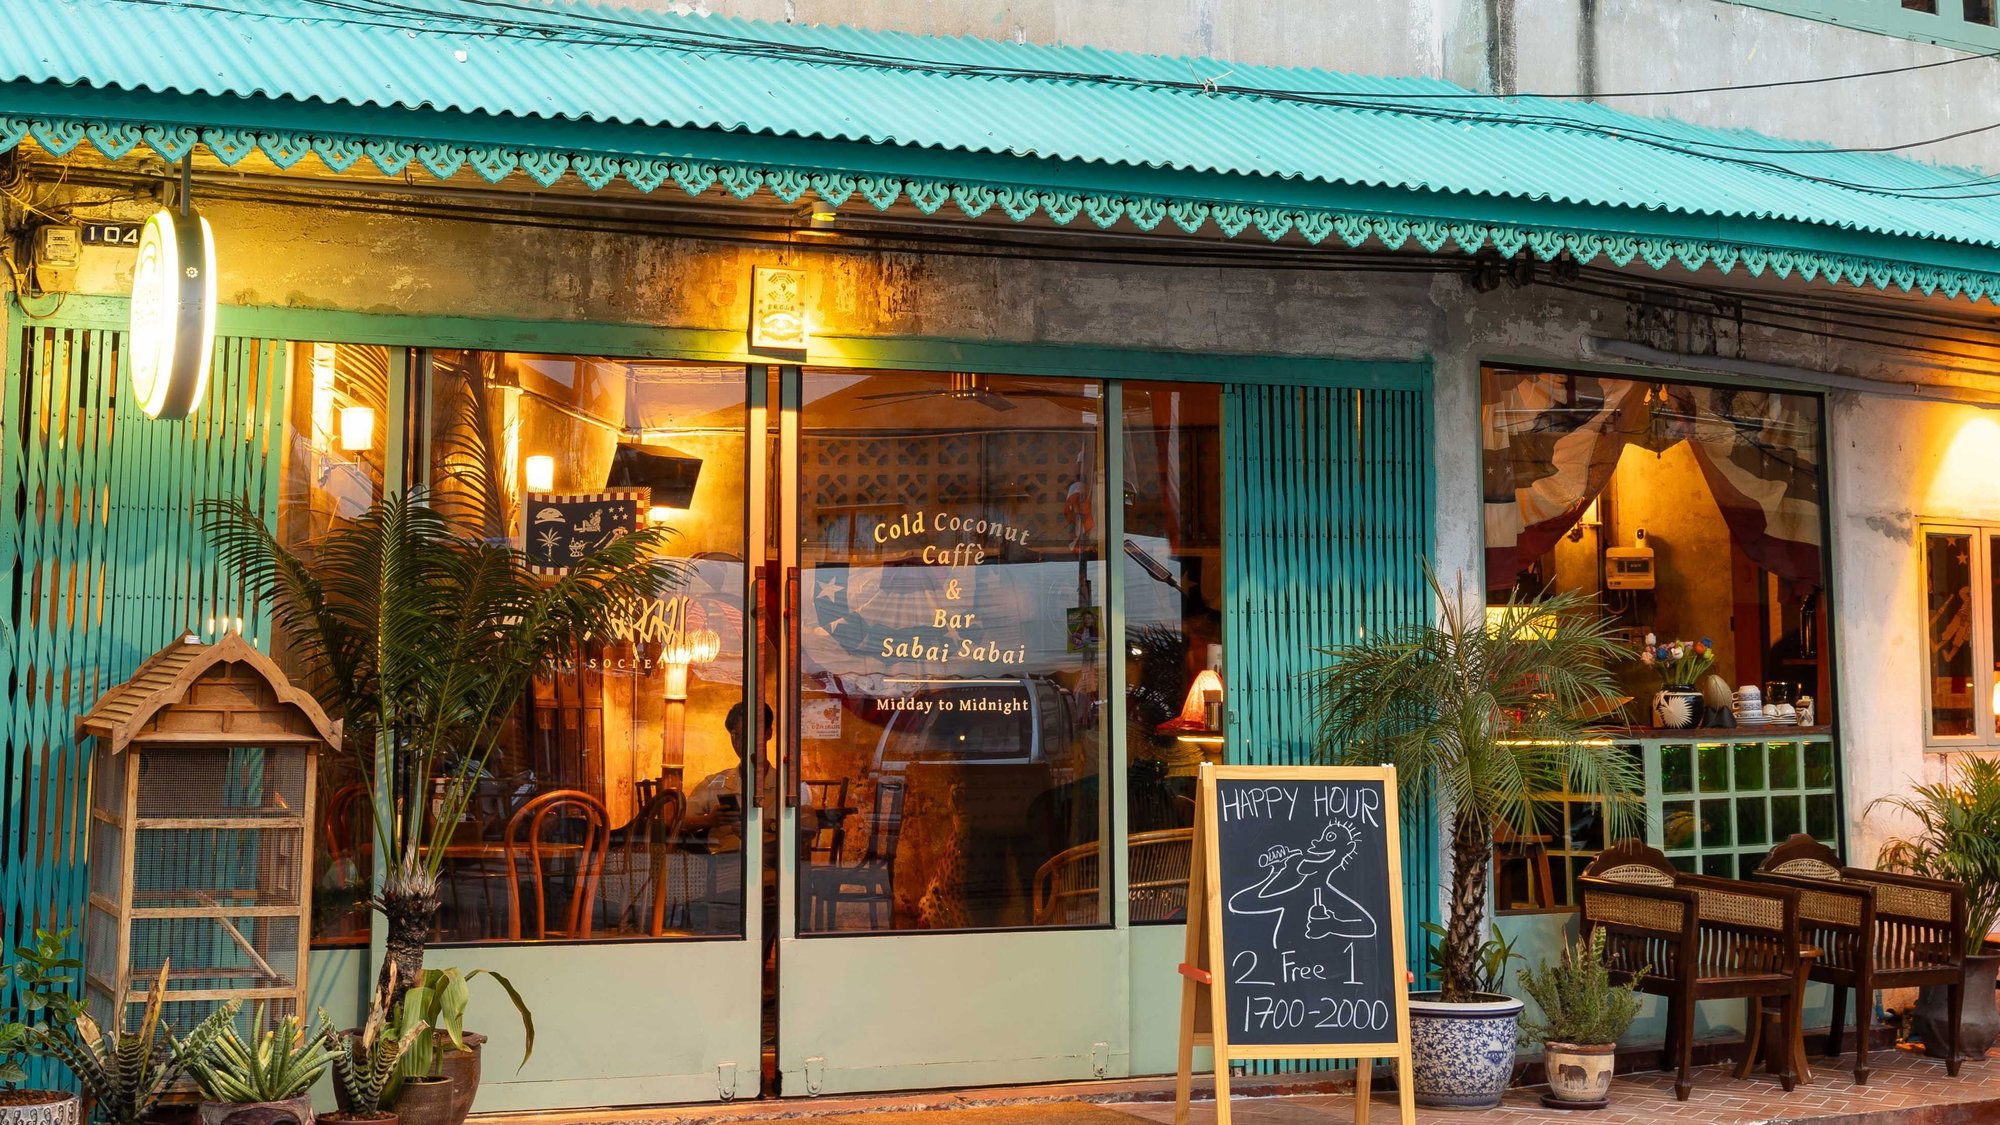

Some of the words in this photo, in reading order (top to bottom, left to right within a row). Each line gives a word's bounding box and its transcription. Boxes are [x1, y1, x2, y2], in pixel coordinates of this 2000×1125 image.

[90, 226, 138, 243] 104
[874, 511, 925, 543] Cold
[934, 512, 1030, 545] Coconut
[945, 578, 963, 600] &
[933, 609, 975, 629] Bar
[881, 636, 949, 662] Sabai
[957, 638, 1025, 664] Sabai
[589, 658, 667, 669] SOCIET
[876, 698, 933, 714] Midday
[939, 700, 953, 711] to
[959, 698, 1029, 714] Midnight
[1220, 786, 1299, 822] HAPPY
[1313, 786, 1379, 828] HOUR
[1232, 950, 1276, 985] 2
[1281, 950, 1327, 983] Free
[1342, 942, 1364, 985] 1
[1243, 996, 1389, 1031] 1700-2000
